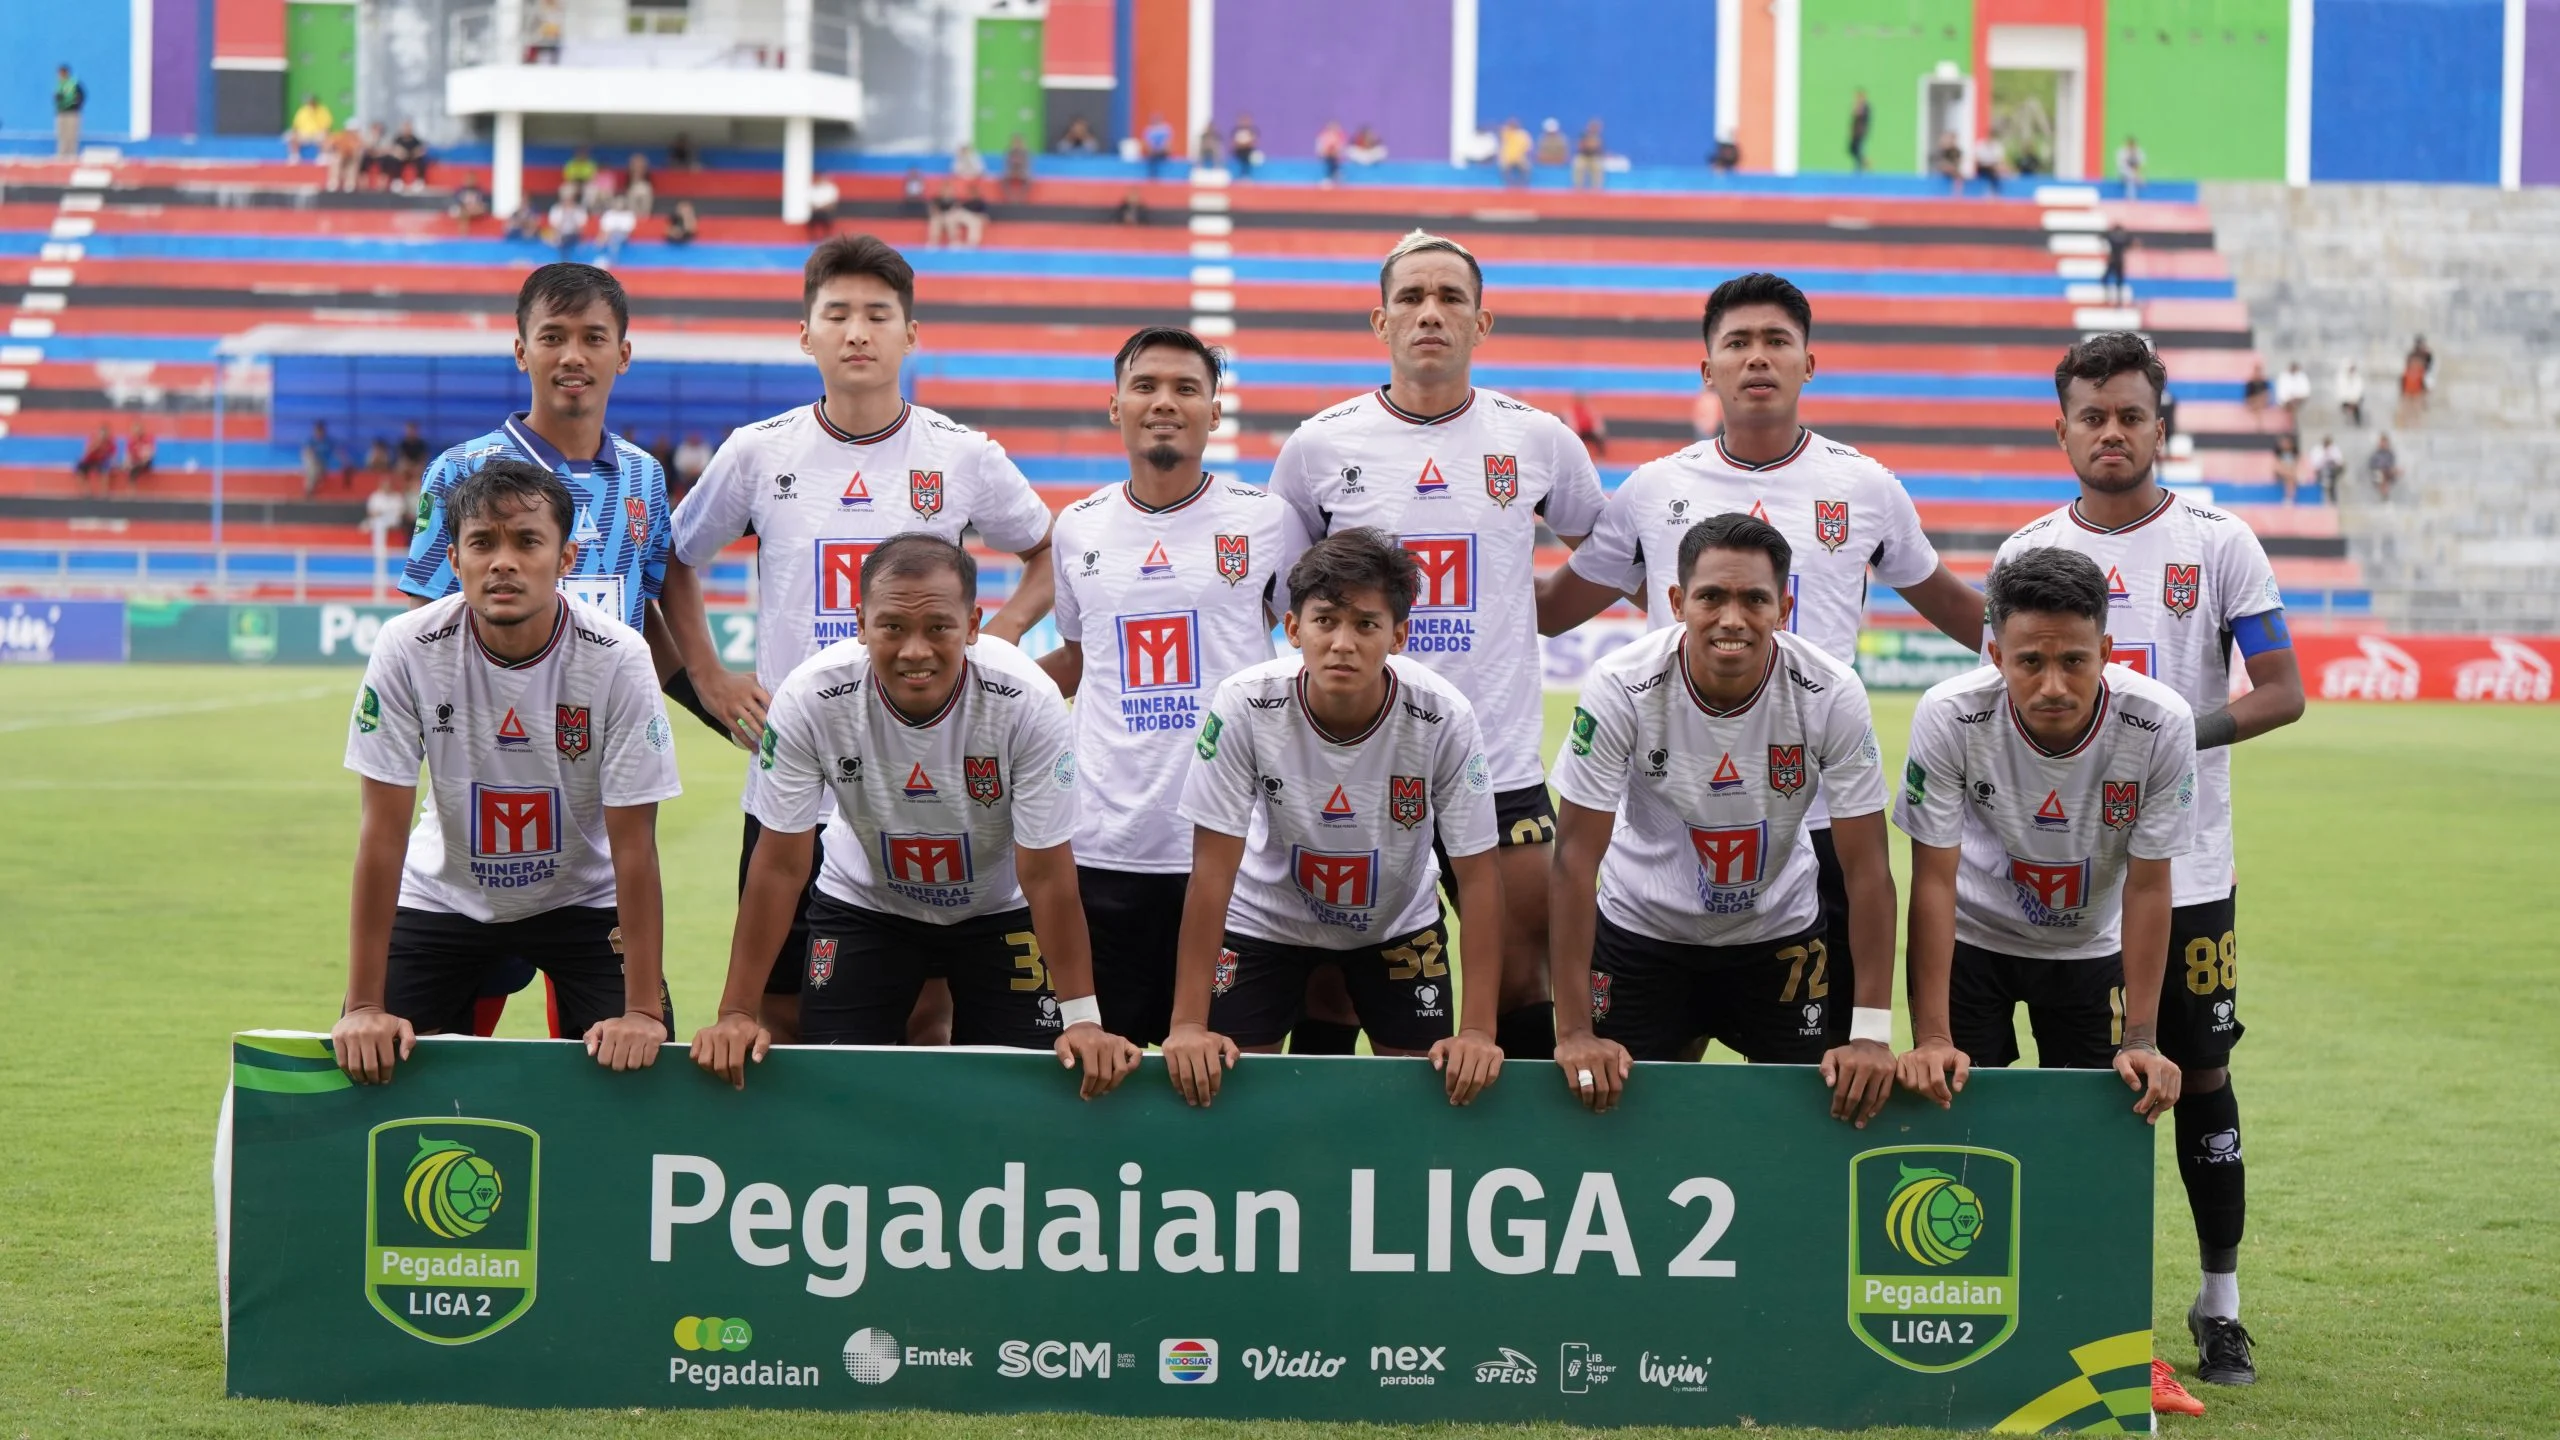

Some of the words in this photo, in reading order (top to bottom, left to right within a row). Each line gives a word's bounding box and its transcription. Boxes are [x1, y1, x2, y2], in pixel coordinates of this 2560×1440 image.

[1341, 486, 1365, 494] TWEVE
[814, 622, 858, 638] MINE
[1408, 618, 1475, 634] INERAL
[1408, 636, 1471, 652] ROBOS
[1121, 695, 1200, 715] MINERAL
[432, 726, 455, 734] TWEVE
[1125, 713, 1196, 732] TROBOS
[470, 858, 561, 875] MINERAL
[475, 869, 554, 888] TROBOS
[887, 882, 975, 898] MINERAL
[1005, 931, 1056, 991] 3
[1776, 938, 1829, 1001] 72
[2185, 929, 2237, 995] 88
[1416, 1009, 1444, 1017] TWEVE
[1798, 1027, 1822, 1035] TWEVE
[650, 1154, 1300, 1298] Pegadaian
[1350, 1167, 1642, 1277] LIGA
[1667, 1177, 1736, 1277] 2
[382, 1251, 520, 1282] Pegadaian
[409, 1292, 471, 1316] LIGA
[475, 1294, 491, 1316] 2
[1865, 1279, 2002, 1310] Pegadaian
[1892, 1320, 1953, 1344] LIGA
[1958, 1322, 1974, 1344] 2
[905, 1346, 973, 1367] Emtek
[997, 1340, 1111, 1378] SCM
[1165, 1357, 1212, 1365] INDOSIAR
[1241, 1345, 1347, 1381] Vidio
[1370, 1346, 1446, 1371] nex
[1586, 1353, 1603, 1363] LIB
[669, 1357, 819, 1391] Pegadaian
[1475, 1368, 1537, 1384] SPECS
[1586, 1363, 1617, 1374] Super
[1380, 1374, 1435, 1387] parabola
[1586, 1373, 1609, 1385] App
